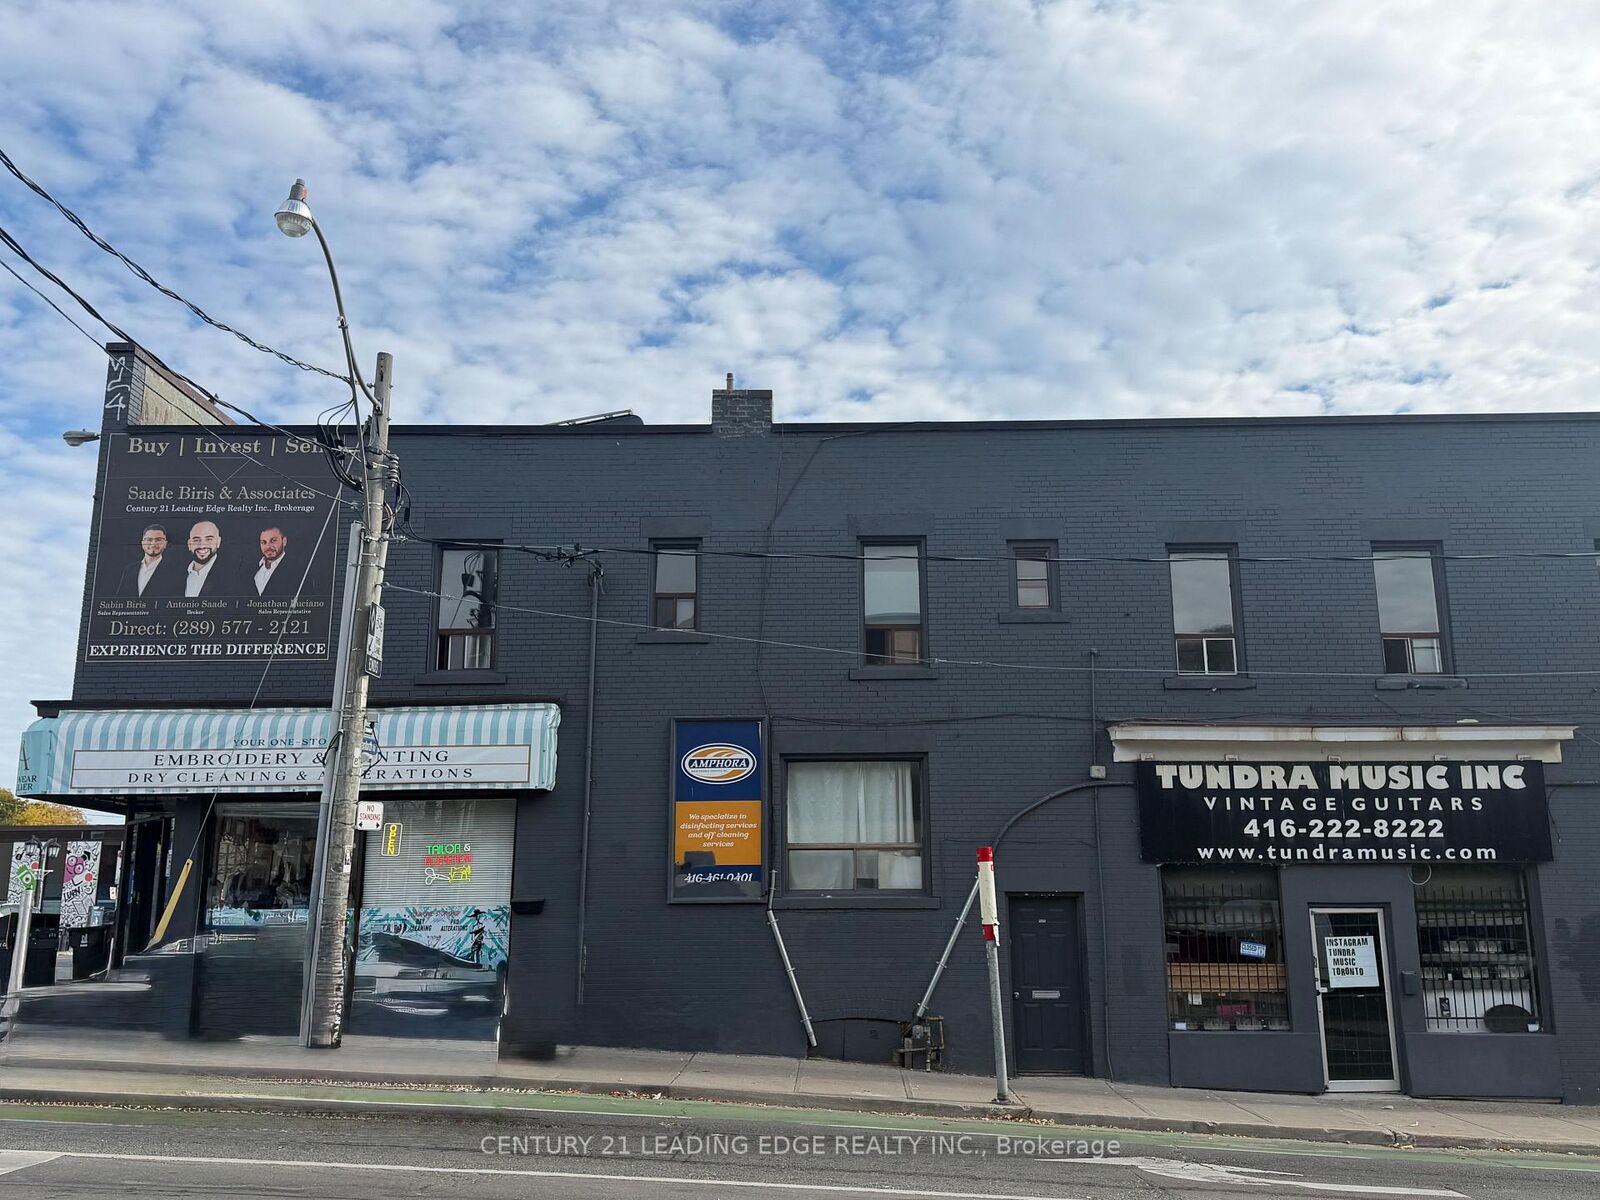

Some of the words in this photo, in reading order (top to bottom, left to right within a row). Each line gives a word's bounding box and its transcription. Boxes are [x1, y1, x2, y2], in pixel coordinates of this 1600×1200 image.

[128, 437, 170, 456] Buy
[194, 437, 261, 453] Invest
[128, 486, 174, 500] Saade
[179, 486, 215, 500] Biris
[219, 486, 234, 500] &
[236, 486, 316, 500] Associates
[126, 504, 158, 514] Century
[159, 504, 169, 513] 21
[171, 504, 204, 514] Leading
[205, 504, 226, 514] Edge
[228, 504, 253, 514] Realty
[255, 504, 272, 514] Inc.,
[274, 504, 315, 514] Brokerage
[99, 600, 124, 609] Sabin
[126, 600, 147, 609] Biris
[166, 600, 200, 608] Antonio
[201, 600, 228, 608] Saade
[247, 600, 288, 608] Jonathan
[109, 620, 167, 636] Direct:
[172, 620, 215, 638] (289)
[221, 620, 252, 634] 577
[268, 620, 310, 634] 2121
[89, 644, 187, 656] EXPERIENCE
[190, 644, 222, 656] THE
[225, 643, 326, 655] DIFFERENCE
[233, 738, 268, 747] YOUR
[270, 737, 327, 747] ONE-STO
[154, 753, 302, 766] EMBROIDERY
[312, 752, 325, 764] &
[378, 750, 449, 763] NTING
[690, 759, 747, 768] AMPHORA
[128, 772, 168, 784] DRY
[177, 771, 287, 783] CLEANING
[296, 770, 307, 781] &
[1155, 764, 1319, 790] TUNDRA
[1329, 764, 1450, 790] MUSIC
[1460, 764, 1527, 790] INC
[1203, 797, 1337, 811] VINTAGE
[1351, 797, 1483, 811] GUITARS
[700, 813, 738, 821] specialize
[680, 822, 725, 831] disinfecting
[1243, 818, 1444, 838] 416-222-8222
[387, 824, 397, 855] OPEN
[716, 832, 749, 840] cleaning
[425, 843, 461, 855] TAILOR
[463, 843, 471, 851] &
[1197, 843, 1497, 860] www.tundramusic.com
[1326, 937, 1369, 947] INSTAGRAM
[1328, 948, 1356, 956] TUNDRA
[1332, 957, 1356, 966] MUSIC
[1332, 967, 1364, 976] TORONTO
